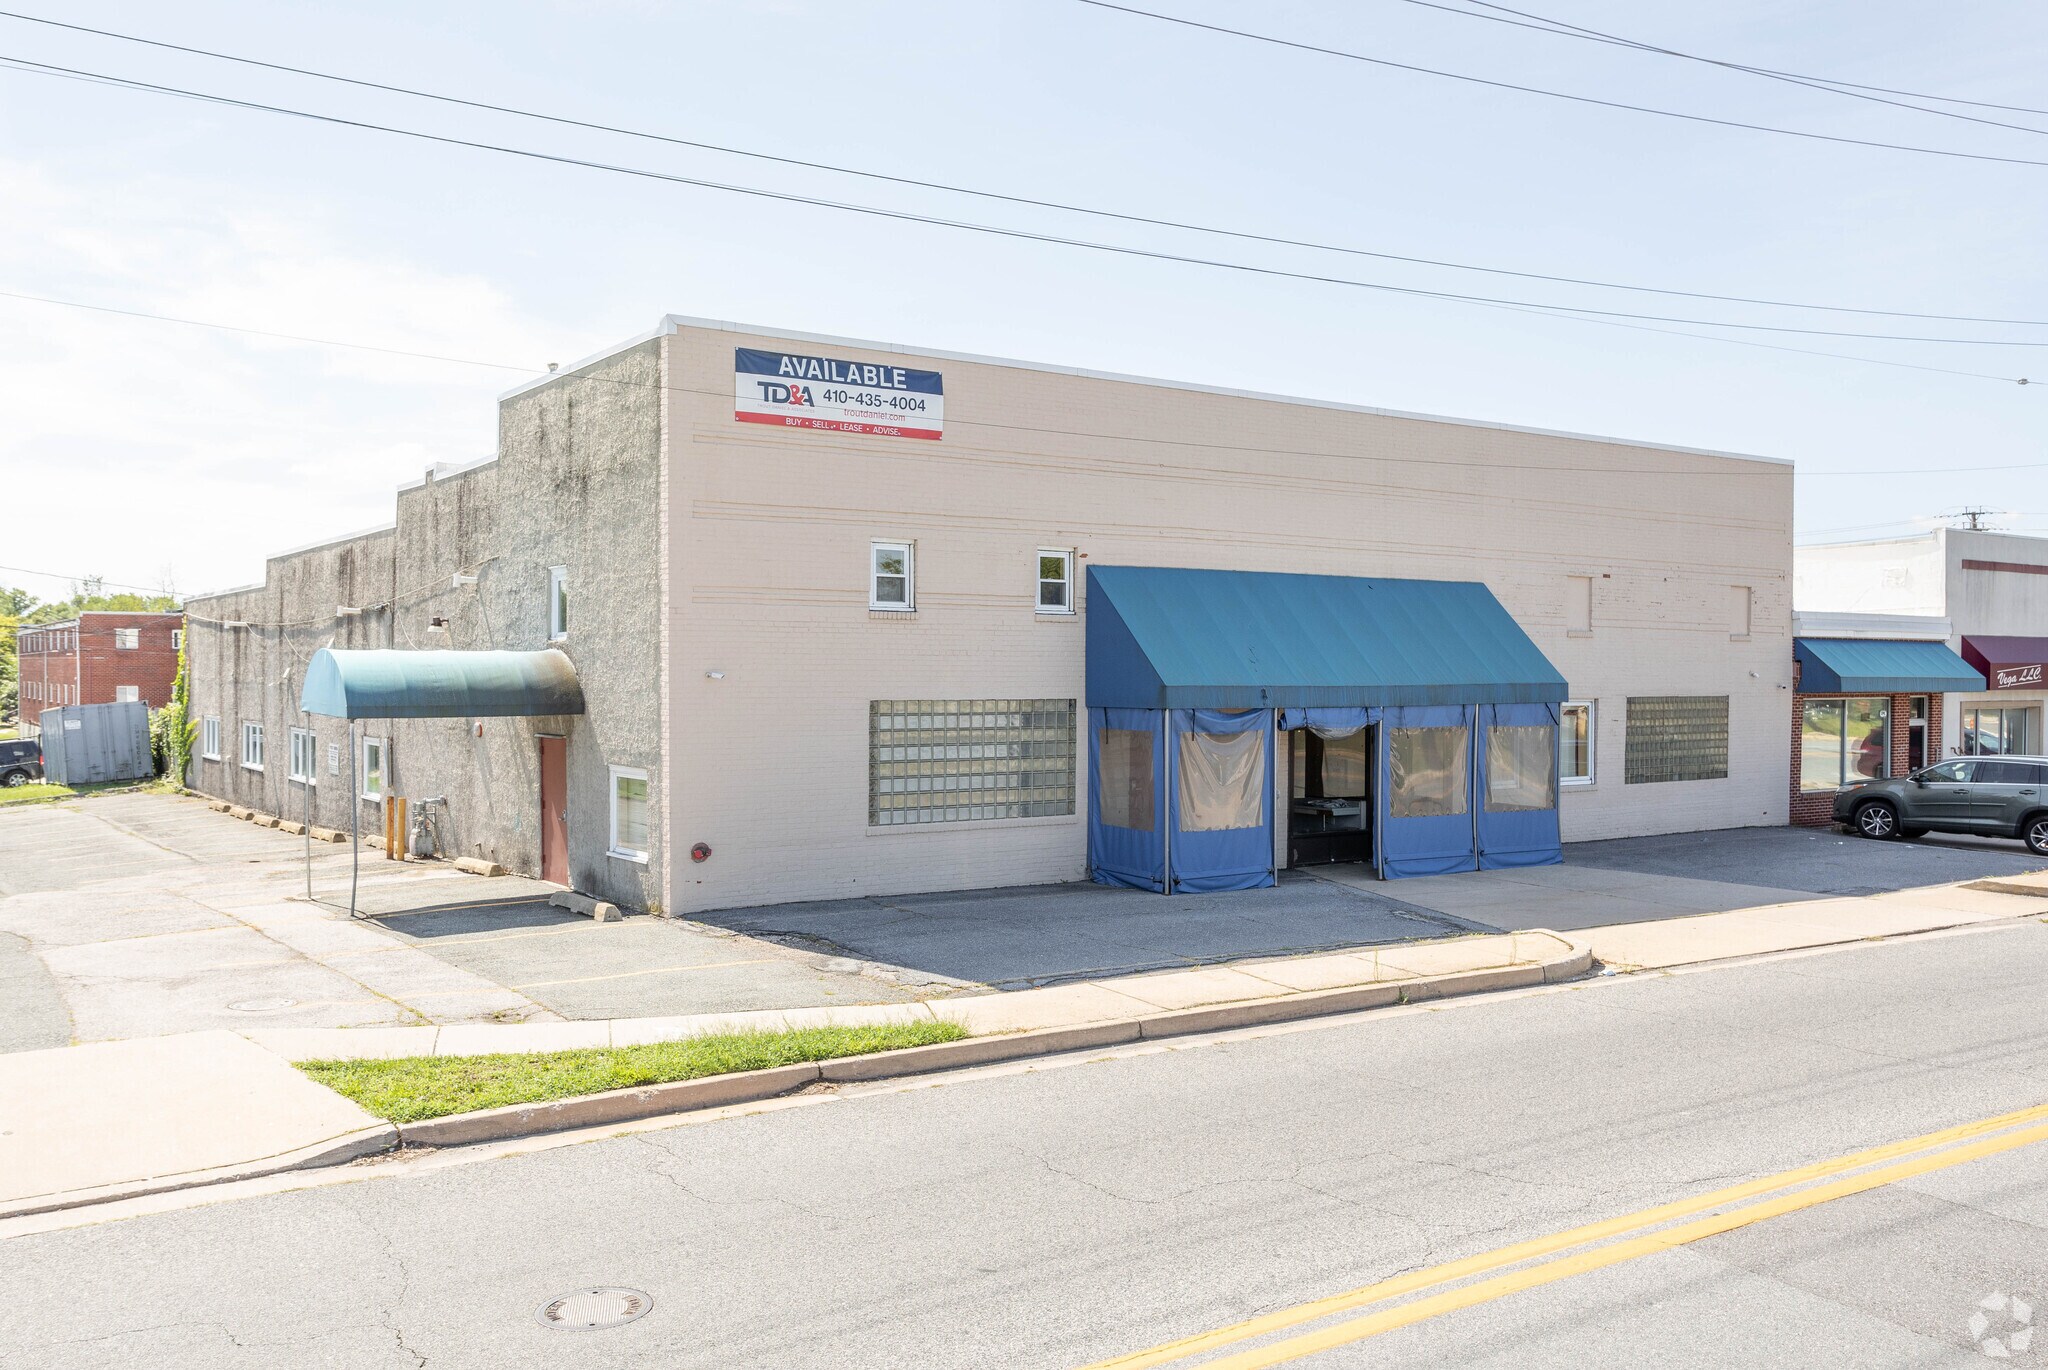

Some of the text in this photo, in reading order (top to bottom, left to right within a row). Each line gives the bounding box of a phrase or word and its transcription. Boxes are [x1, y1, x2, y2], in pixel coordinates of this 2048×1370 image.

[779, 356, 907, 389] AVAILABLE
[757, 381, 815, 407] TD&A
[823, 389, 926, 412] 410-435-4004
[785, 417, 803, 426] BUY
[812, 420, 829, 429] SELL
[839, 423, 863, 432] LEASE
[844, 408, 906, 422] troutdaniel.com
[1997, 673, 2018, 688] Vega
